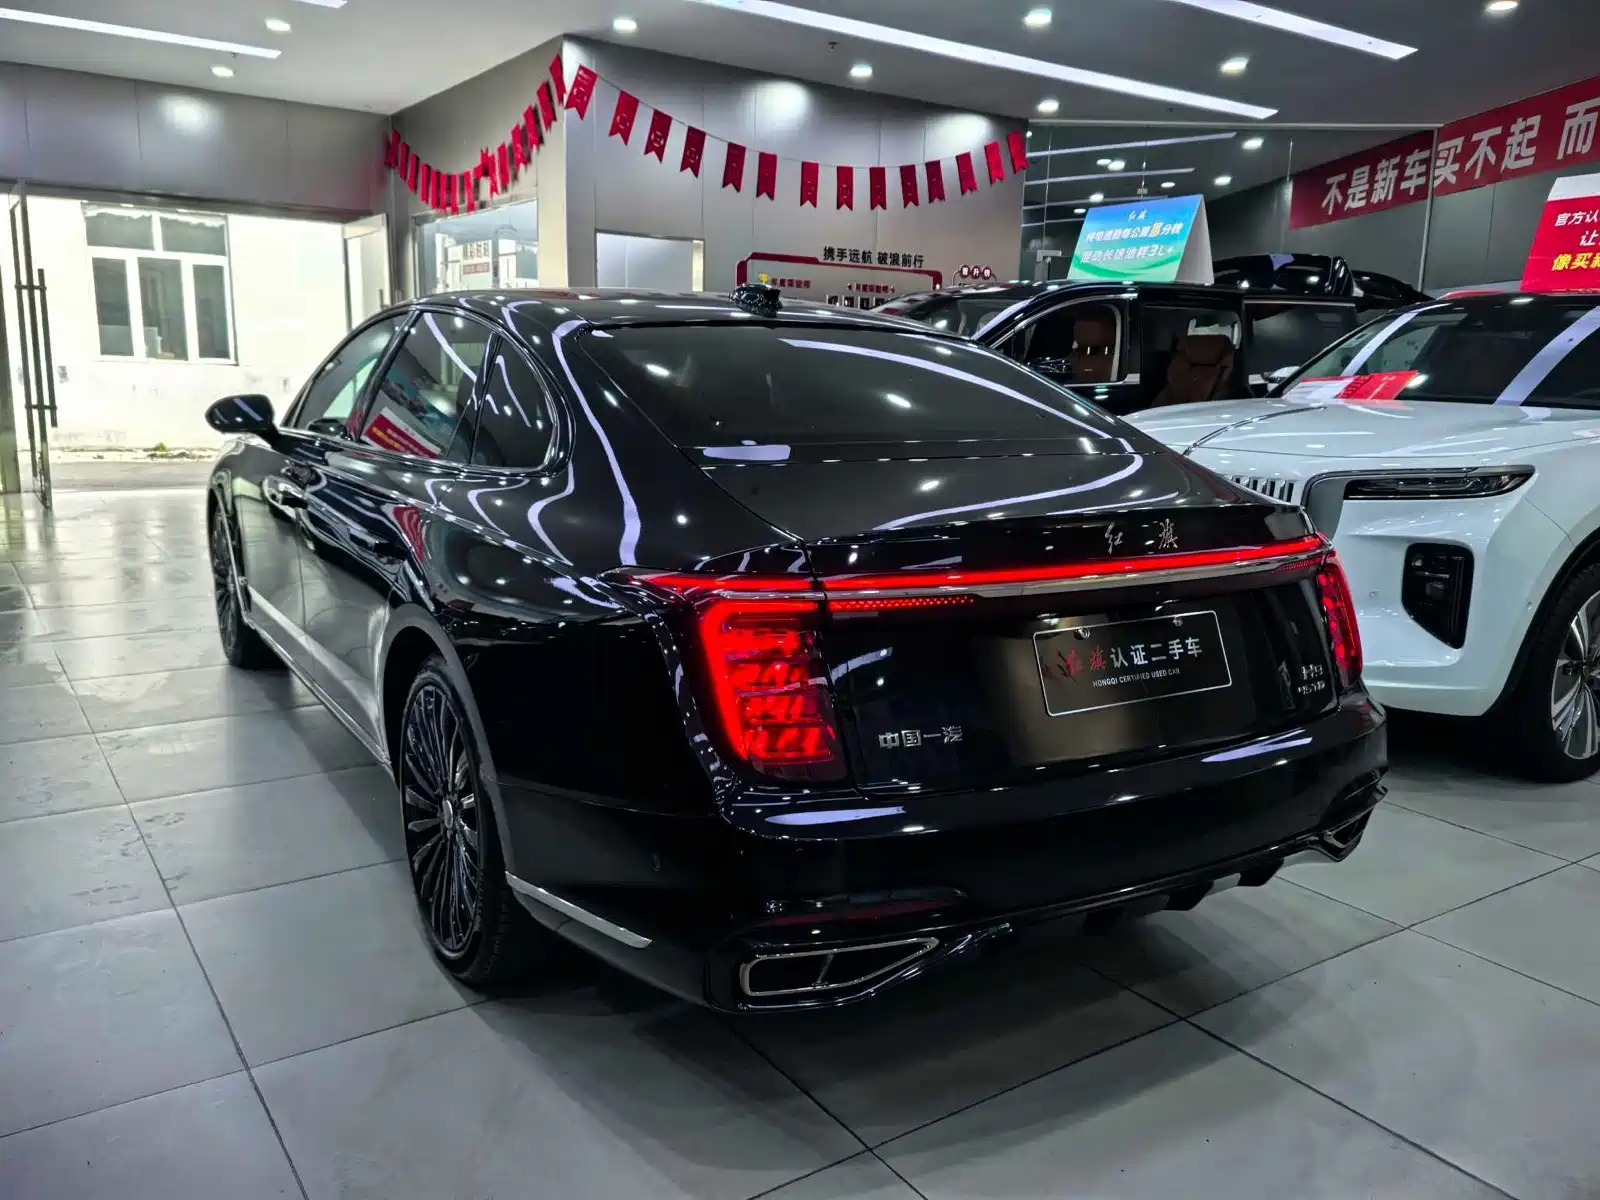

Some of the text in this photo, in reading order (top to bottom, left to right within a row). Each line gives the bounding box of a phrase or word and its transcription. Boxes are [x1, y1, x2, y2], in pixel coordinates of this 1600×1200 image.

[1321, 96, 1600, 216] 不是新车买不起 而
[1554, 209, 1600, 227] 官方认
[1579, 229, 1600, 247] 让
[823, 245, 924, 269] 携手远航 破浪前行
[1092, 667, 1180, 688] HONGQI CERTIFIED USED CAR
[878, 725, 963, 749] 中国一汽
